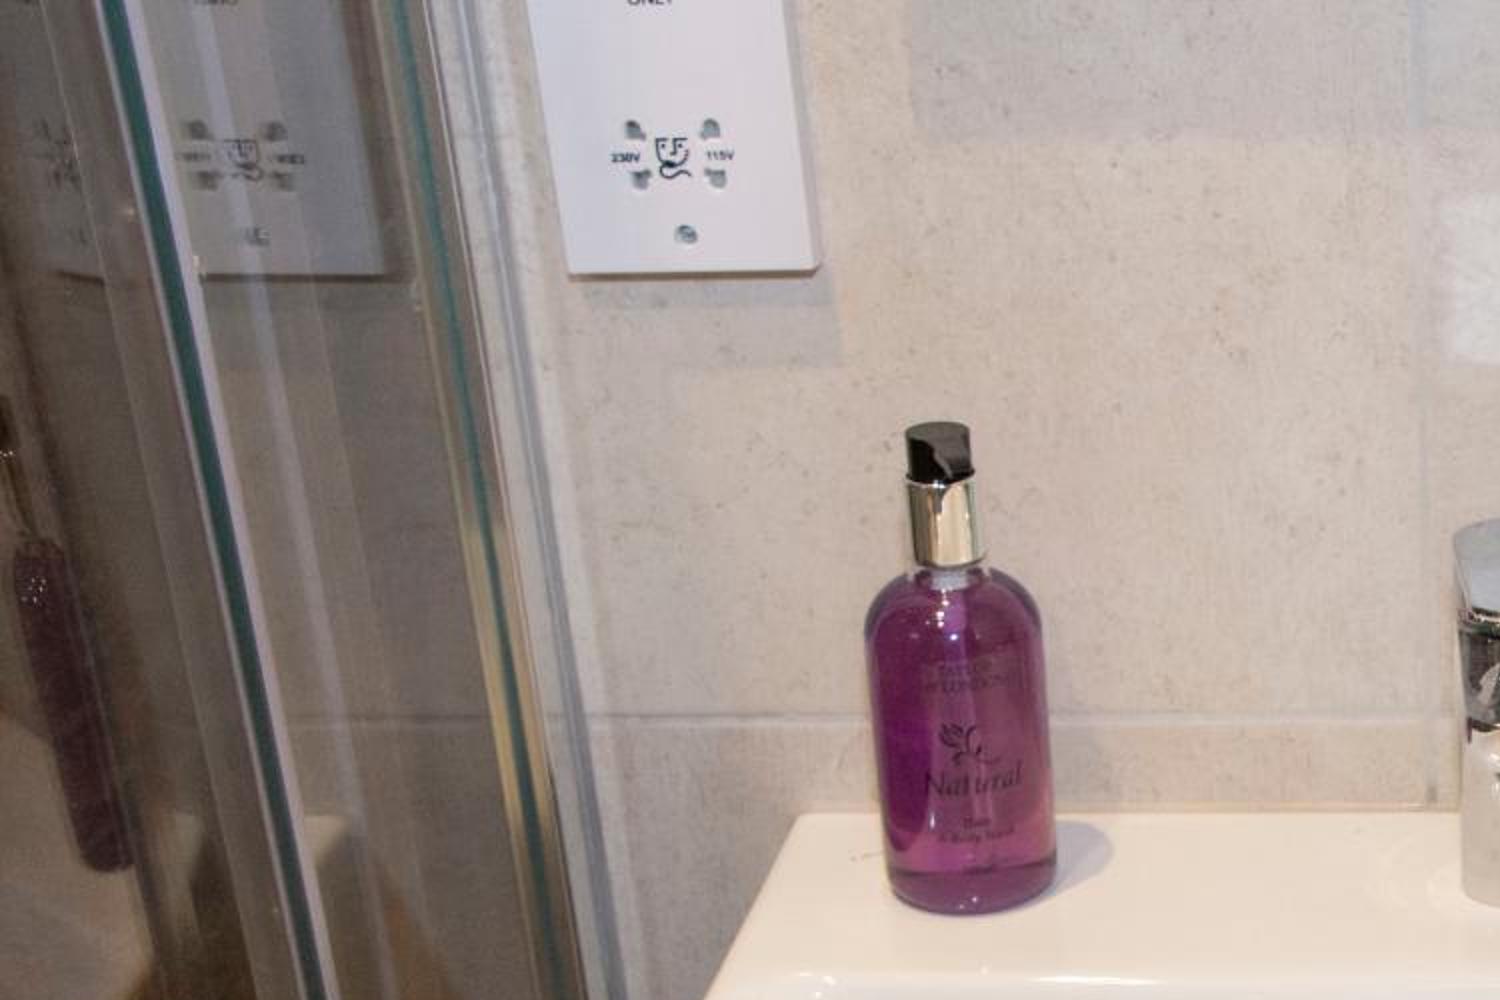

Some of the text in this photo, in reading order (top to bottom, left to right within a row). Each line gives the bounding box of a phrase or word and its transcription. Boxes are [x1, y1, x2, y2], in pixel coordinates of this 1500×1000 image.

[610, 151, 641, 163] 230V
[706, 148, 735, 161] 115V
[924, 760, 1022, 798] Natural
